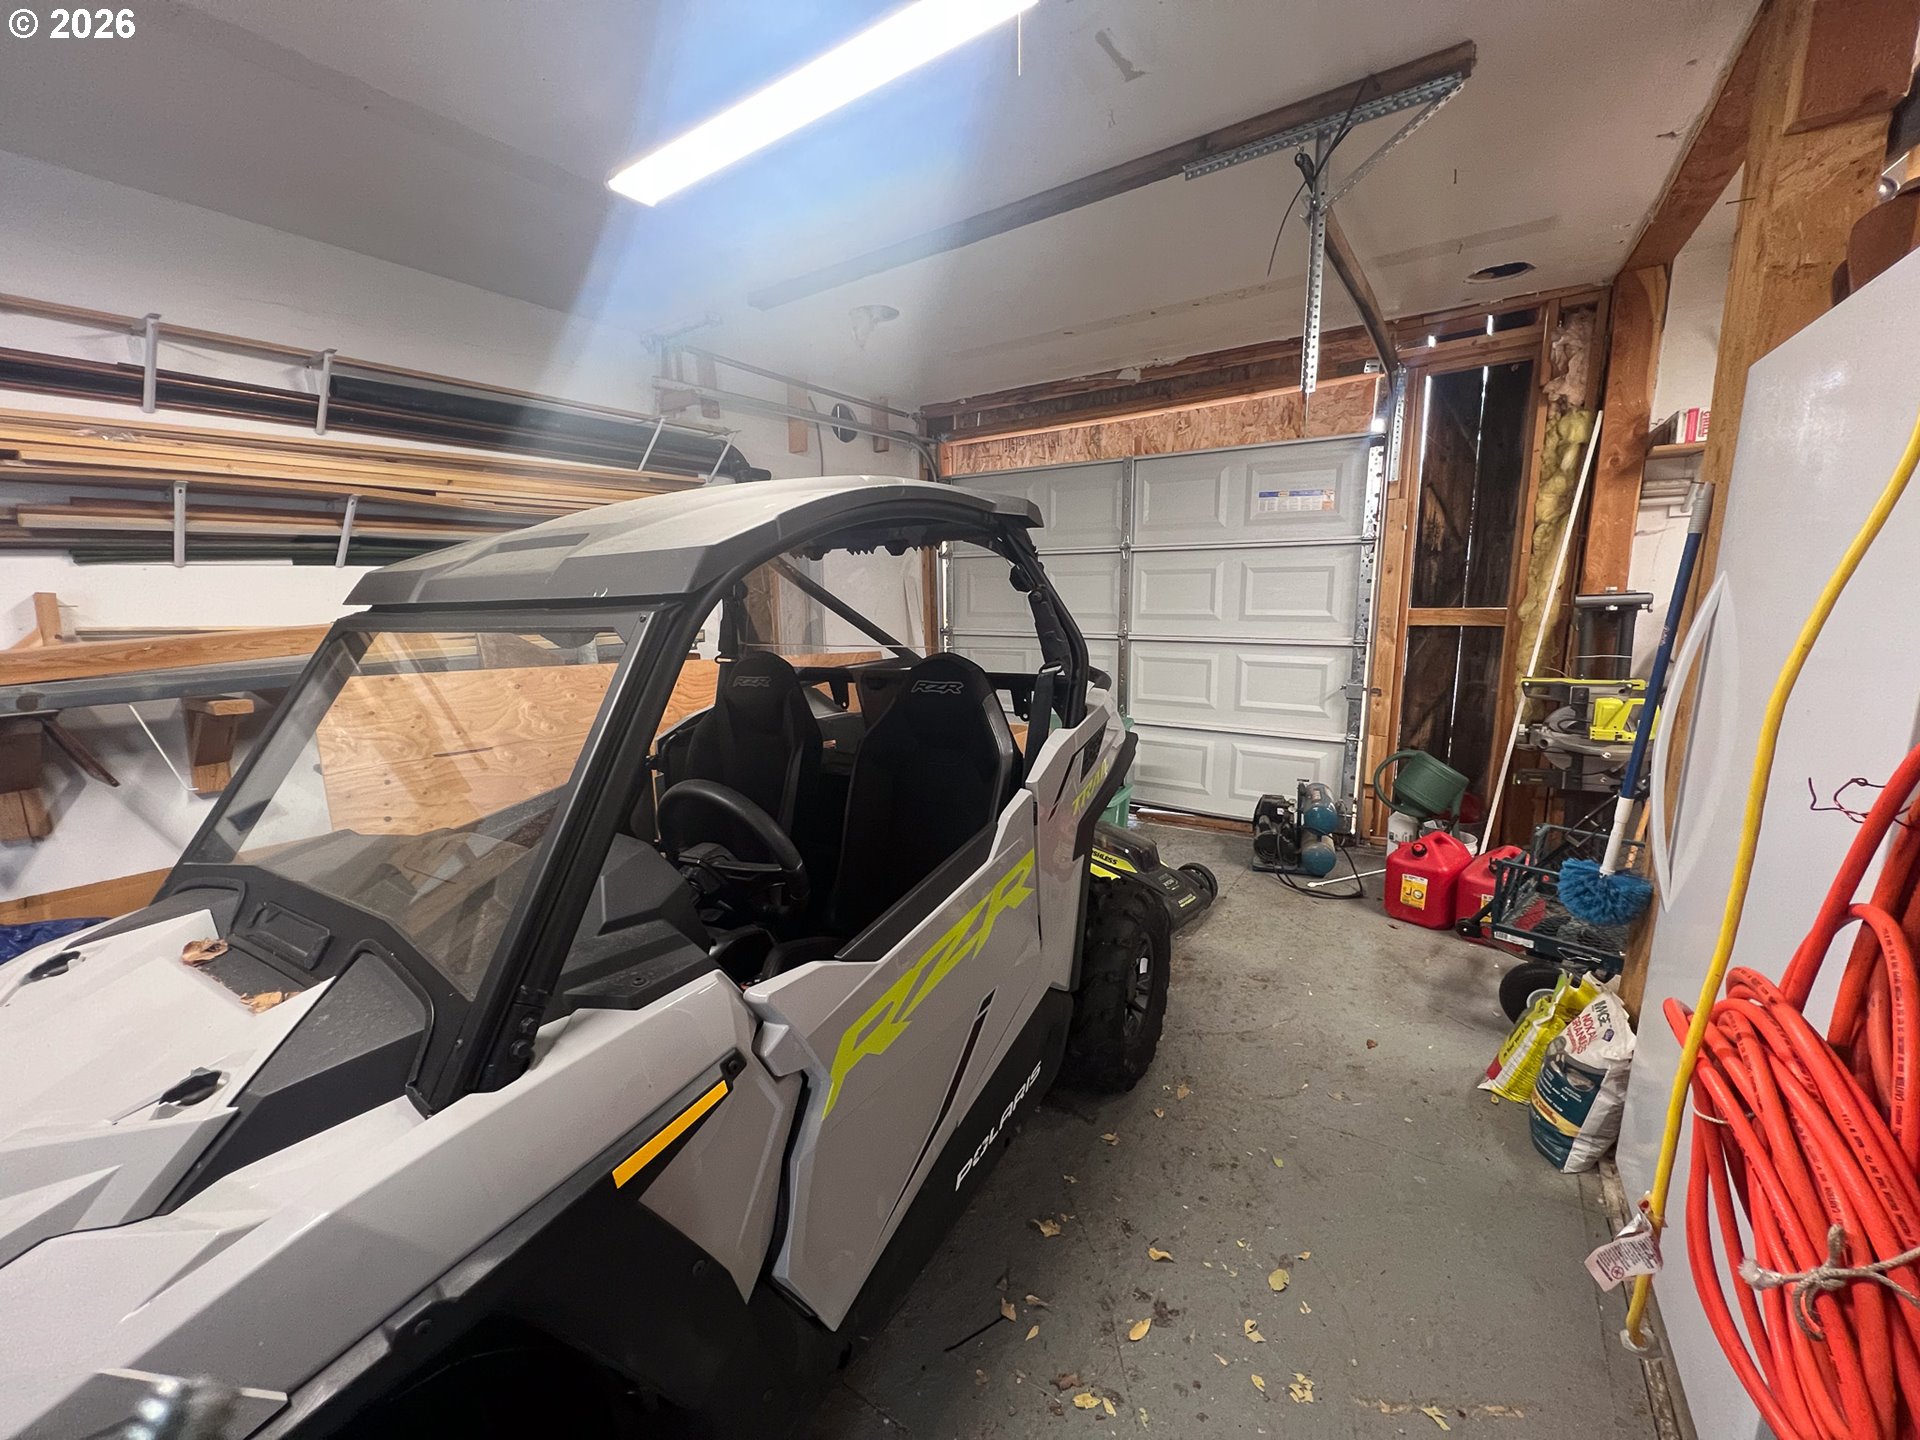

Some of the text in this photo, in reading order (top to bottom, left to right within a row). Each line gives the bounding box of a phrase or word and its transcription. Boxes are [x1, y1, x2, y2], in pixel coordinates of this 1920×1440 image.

[732, 675, 771, 688] RZR
[910, 680, 964, 695] RZR
[822, 848, 1036, 1121] RZR
[954, 1059, 1043, 1192] POLARIS
